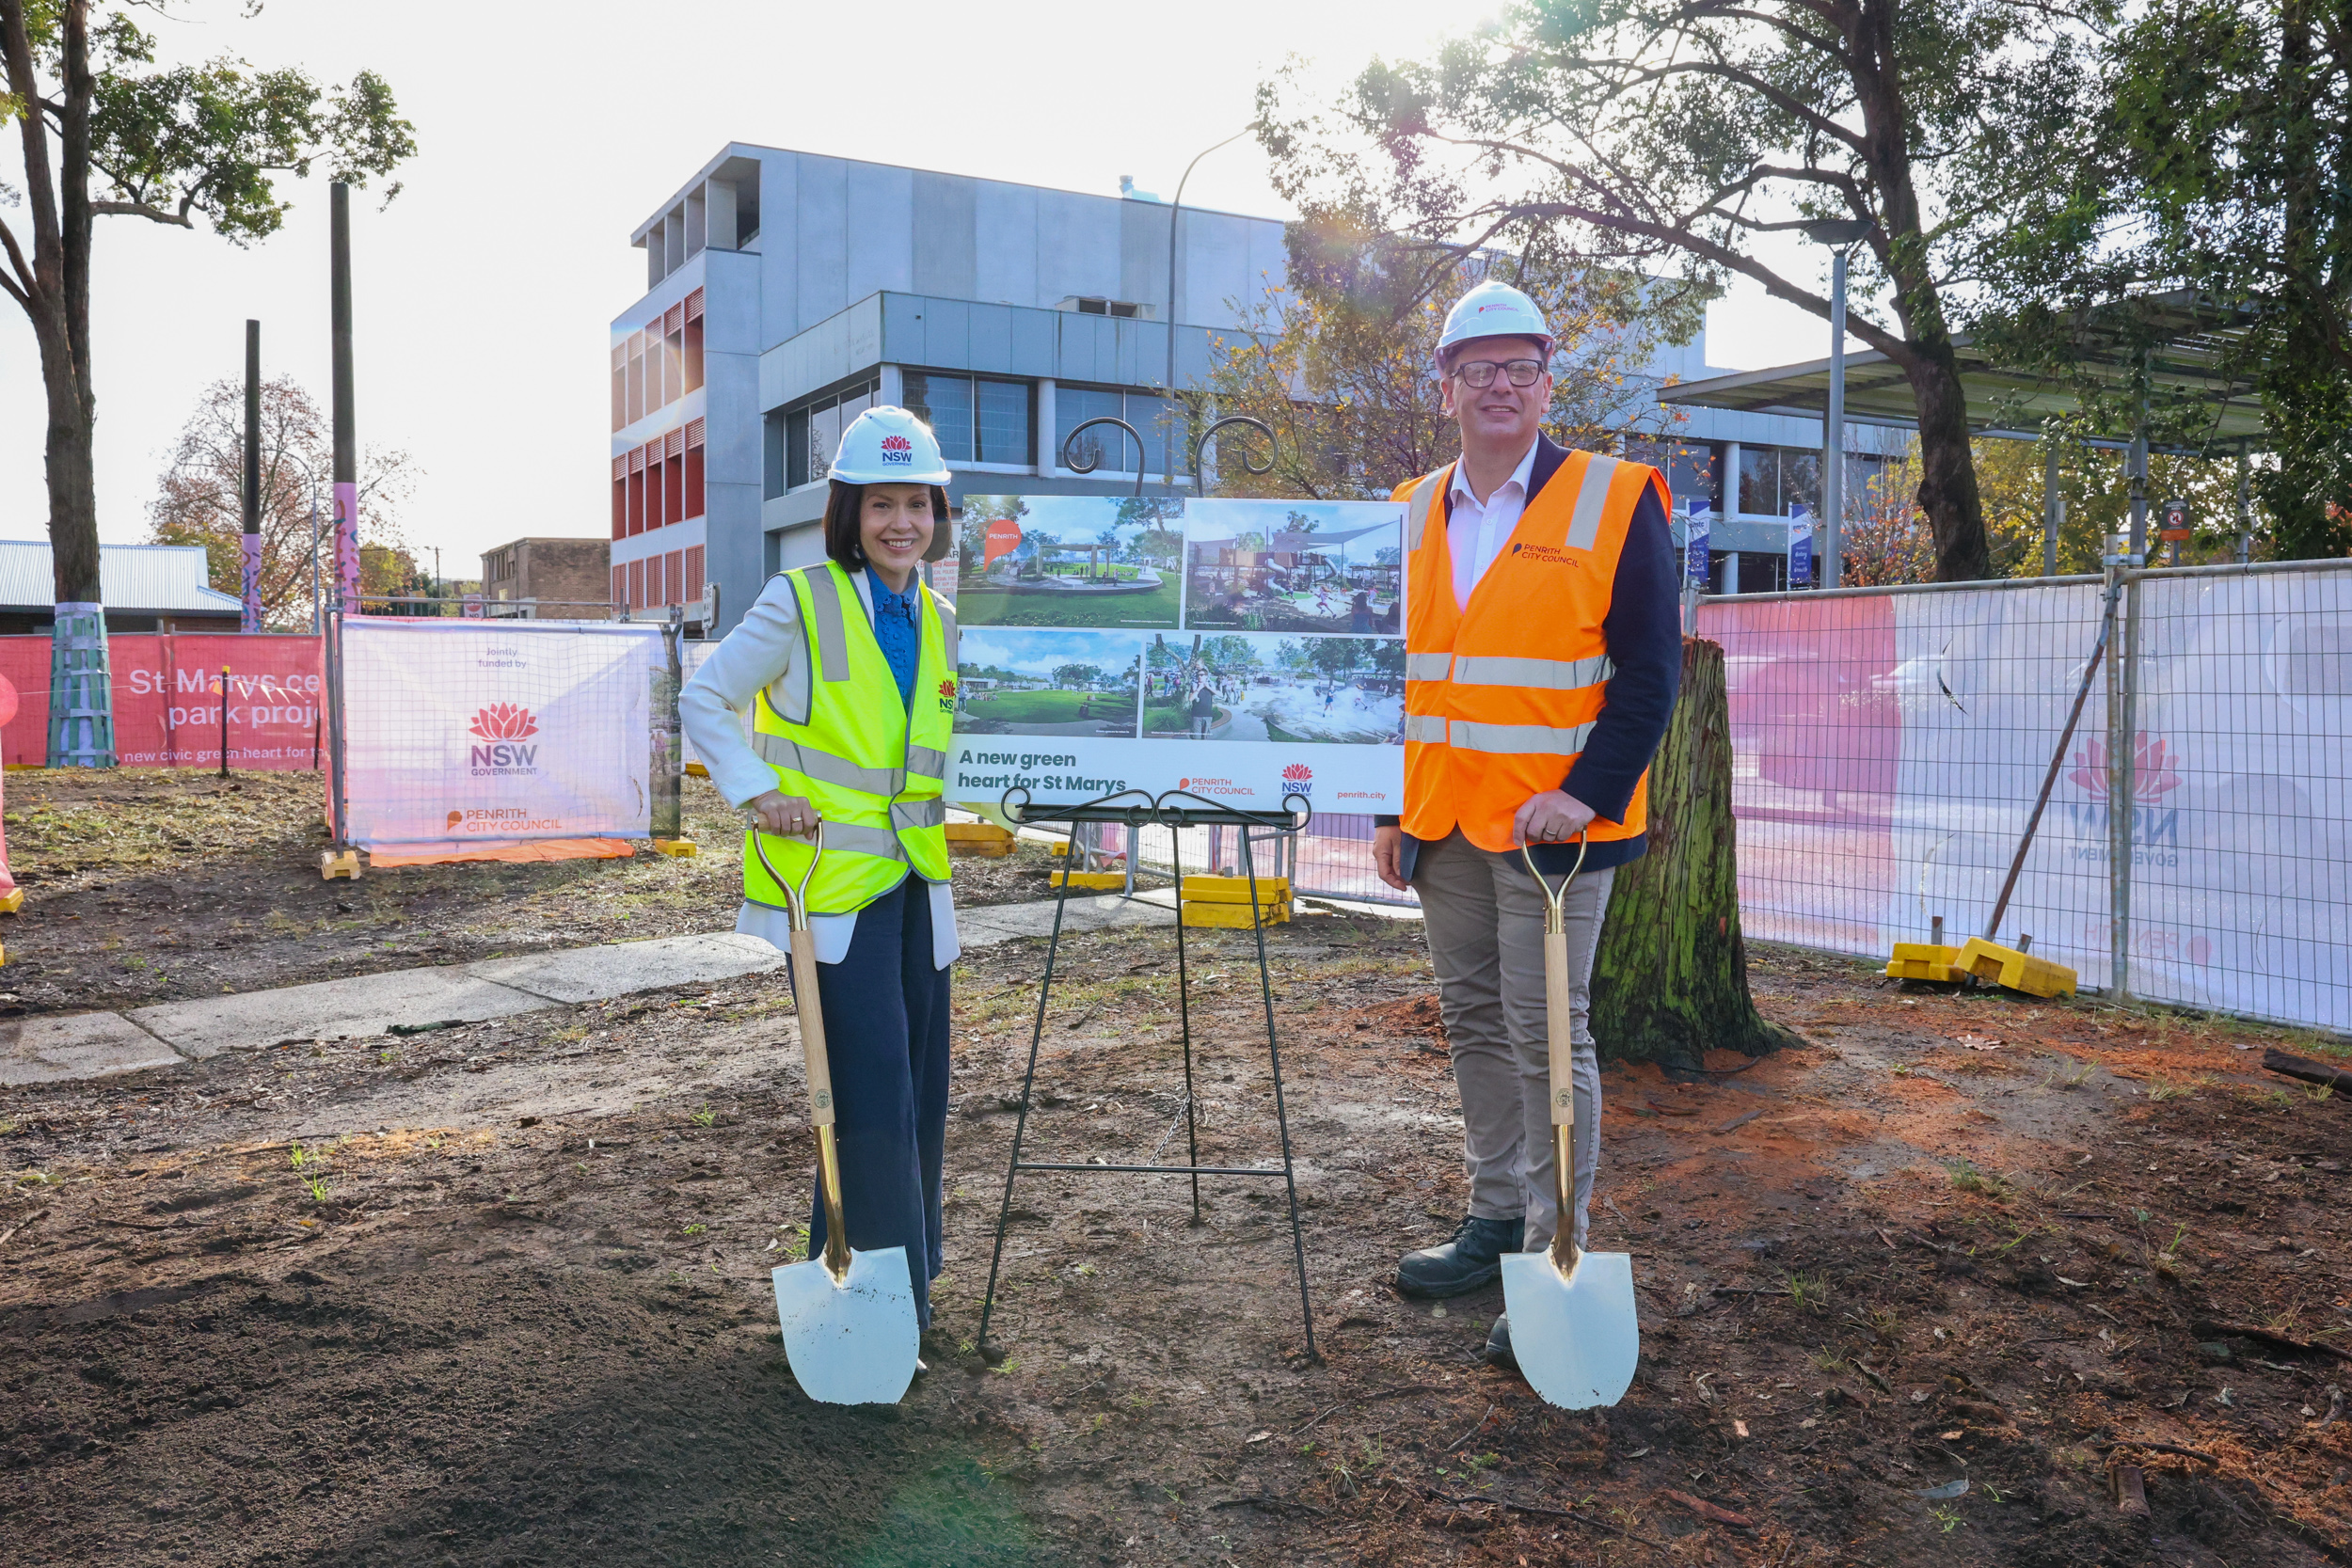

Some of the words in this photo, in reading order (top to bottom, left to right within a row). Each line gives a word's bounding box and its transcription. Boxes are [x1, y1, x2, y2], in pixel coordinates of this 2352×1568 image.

[882, 451, 912, 462] NSW
[1524, 544, 1561, 555] PENRITH
[1521, 551, 1541, 561] CITY
[1541, 555, 1580, 568] COUNCIL
[486, 647, 517, 657] Jointly
[478, 659, 513, 668] funded
[515, 659, 527, 669] by
[129, 669, 167, 694] St
[177, 669, 277, 698] Marys
[285, 674, 320, 692] ce
[939, 698, 954, 709] NS
[168, 700, 241, 730] park
[124, 753, 156, 762] new
[159, 750, 193, 761] civic
[243, 748, 282, 759] heart
[286, 747, 307, 758] for
[471, 744, 538, 767] NSW
[959, 750, 973, 764] A
[977, 752, 1017, 765] new
[1020, 753, 1076, 770] green
[471, 768, 538, 776] GOVERNMENT
[958, 772, 1010, 788] heart
[1013, 773, 1041, 789] for
[1042, 775, 1062, 790] St
[1065, 776, 1126, 796] Marys
[1281, 782, 1312, 792] NSW
[1337, 791, 1386, 800] penrith.city
[467, 808, 527, 820] PENRITH
[466, 821, 498, 832] CITY
[501, 819, 562, 831] COUNCIL
